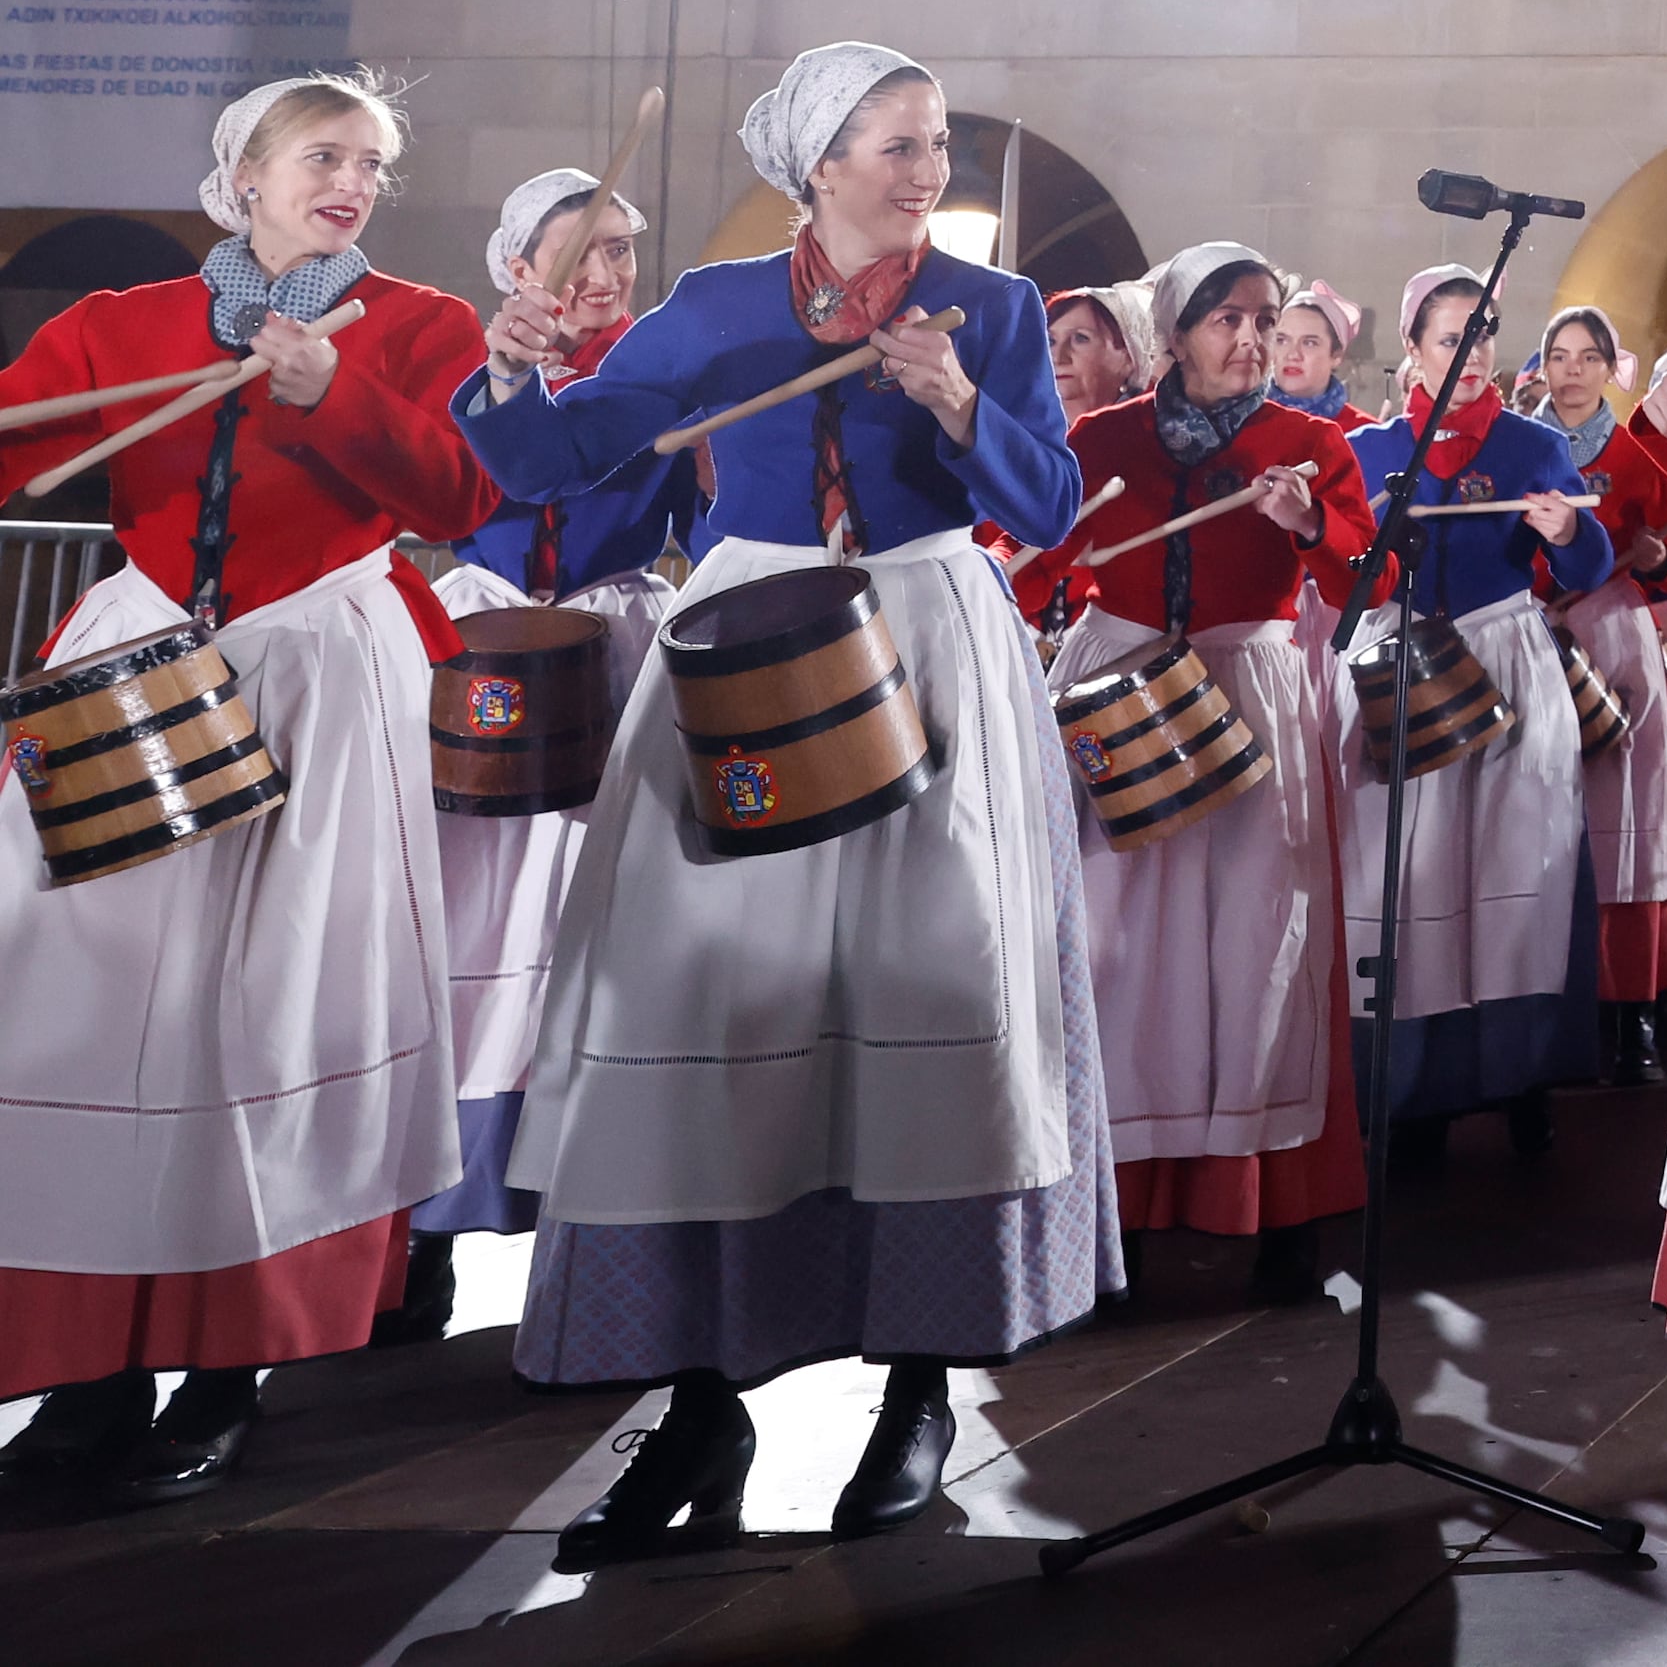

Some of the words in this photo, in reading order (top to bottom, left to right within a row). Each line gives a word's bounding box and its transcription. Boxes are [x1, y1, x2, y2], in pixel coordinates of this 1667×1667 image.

[6, 6, 55, 23] ADIN
[33, 54, 113, 70] FIESTAS
[119, 56, 145, 71] DE
[151, 56, 254, 72] DONOSTIA
[101, 79, 128, 95] DE
[134, 80, 189, 96] EDAD
[195, 81, 214, 97] NI
